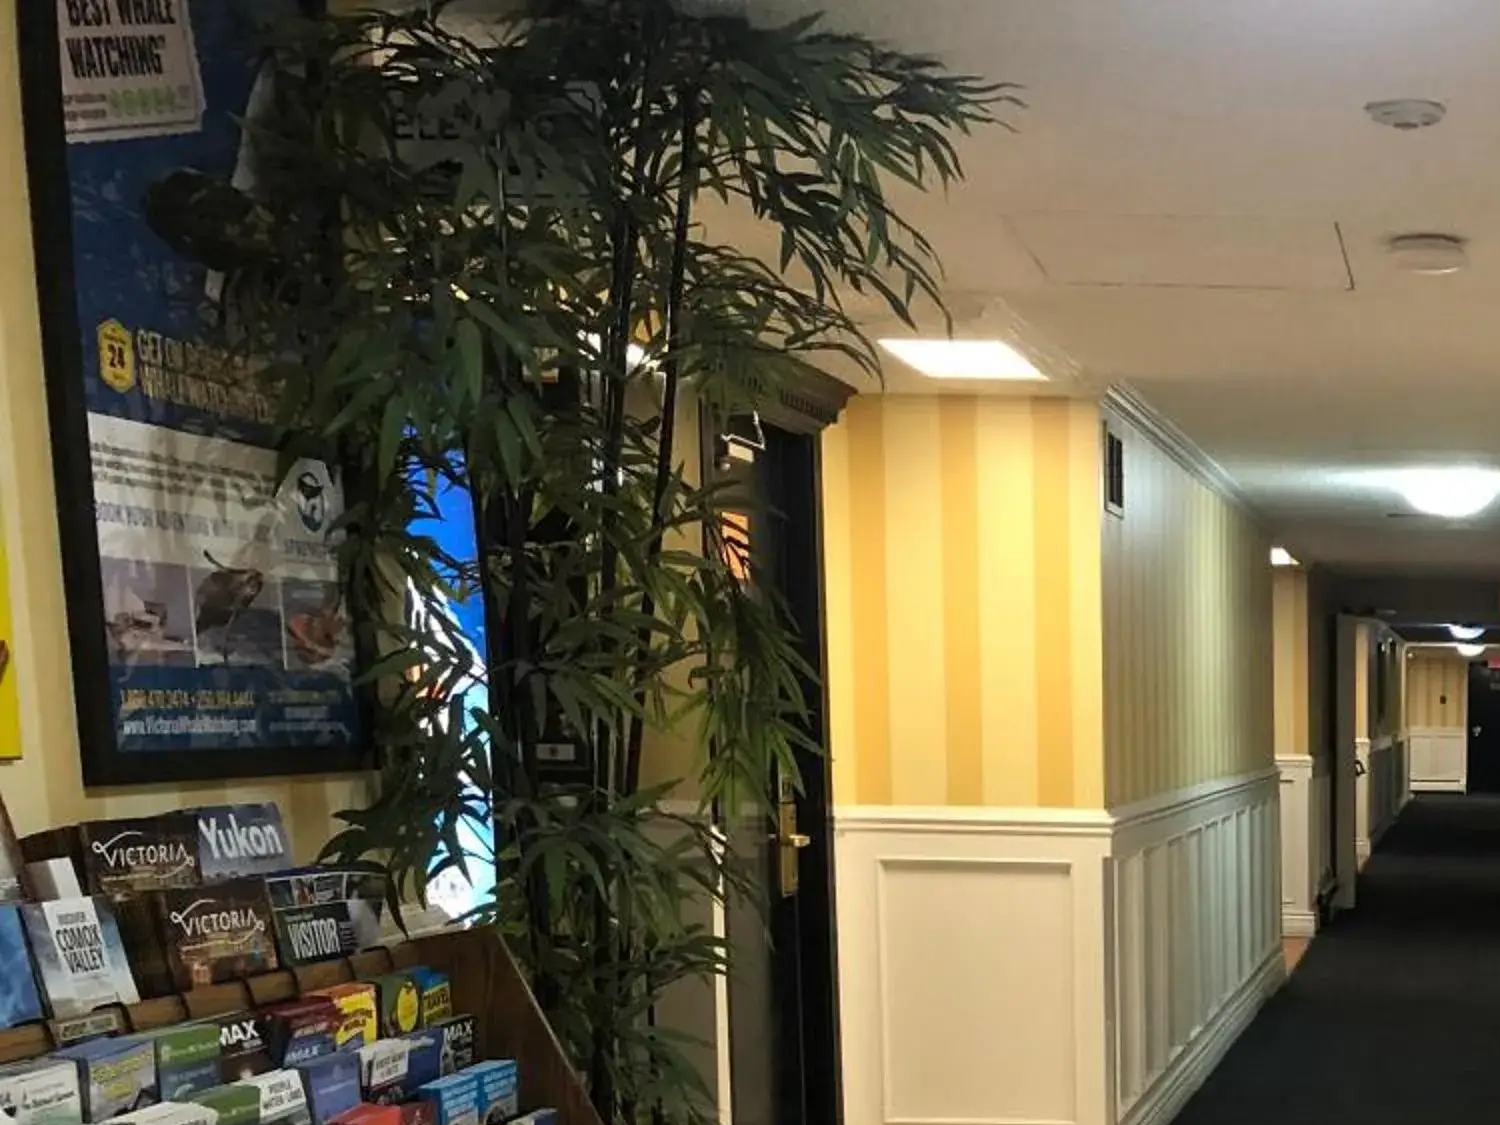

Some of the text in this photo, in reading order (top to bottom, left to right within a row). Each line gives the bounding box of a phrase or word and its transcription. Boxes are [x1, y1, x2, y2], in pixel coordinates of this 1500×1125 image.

[66, 0, 176, 26] BEST WHALE
[107, 342, 126, 370] 24
[92, 834, 194, 869] VICTORIA
[197, 813, 284, 860] Yukon
[170, 902, 265, 938] VICTORIA
[55, 923, 103, 952] COMOX
[287, 916, 341, 961] VISITOR
[63, 947, 105, 974] VALLEY
